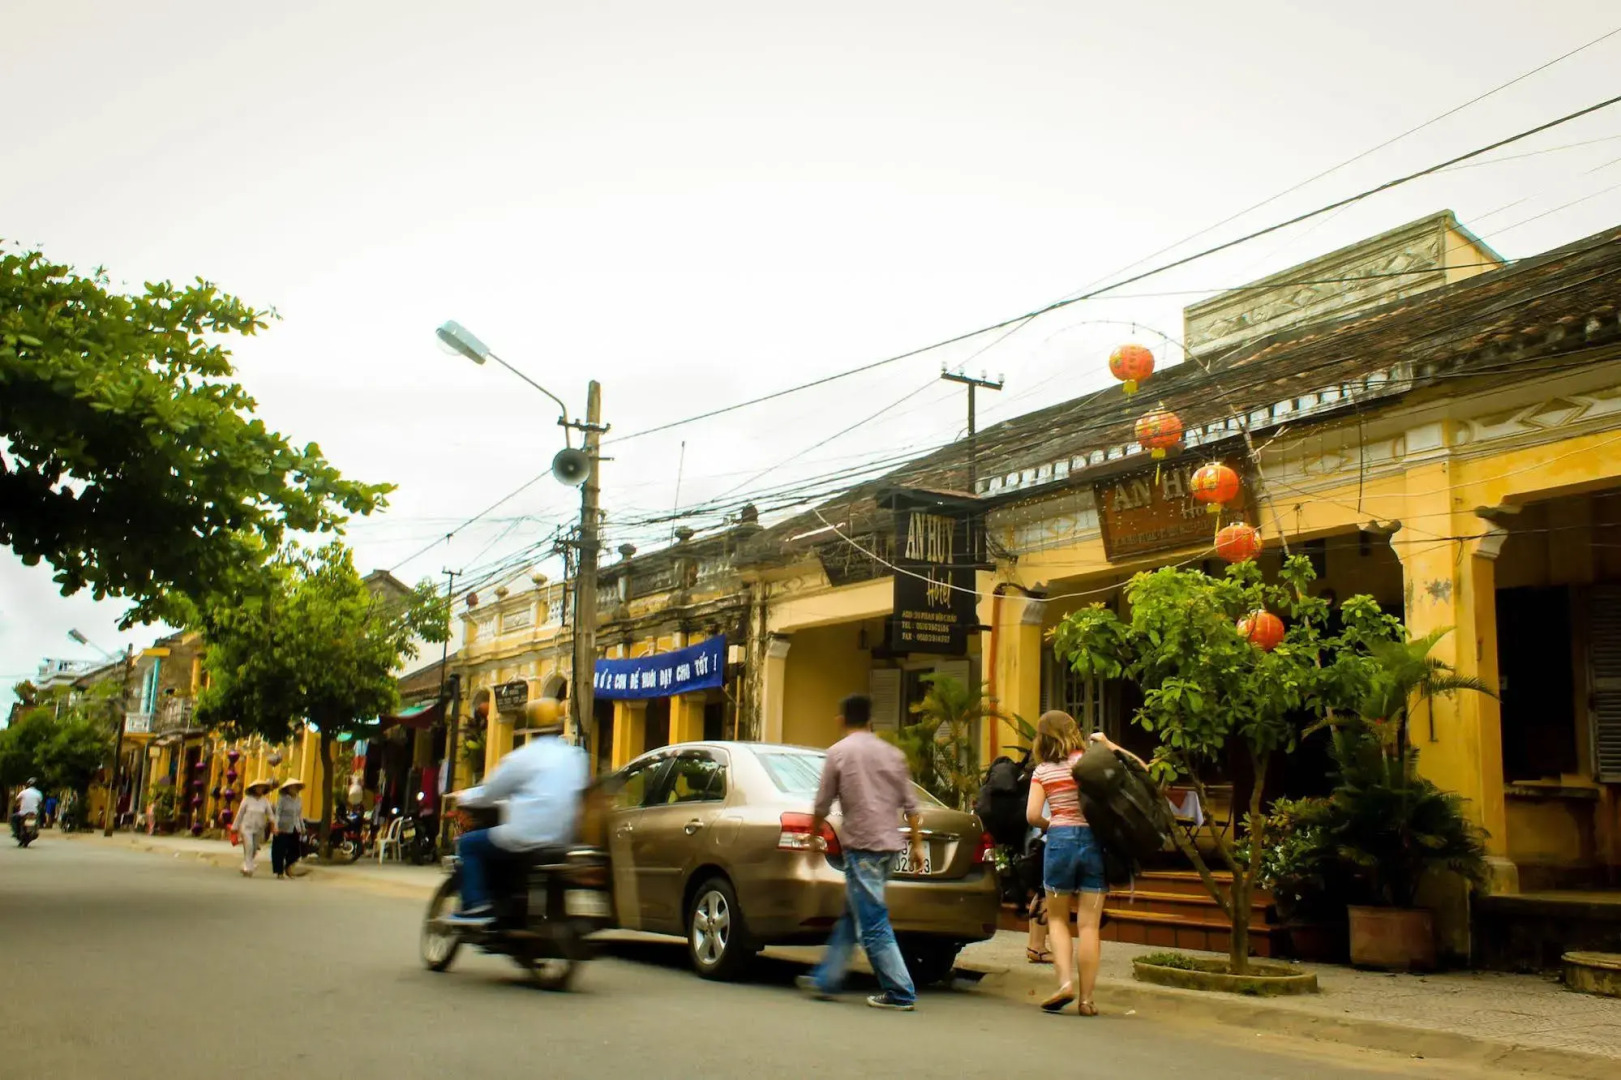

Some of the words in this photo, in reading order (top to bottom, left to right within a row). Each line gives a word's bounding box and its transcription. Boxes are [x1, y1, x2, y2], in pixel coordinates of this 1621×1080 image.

[1112, 476, 1152, 512] AN
[905, 512, 926, 561] AN
[927, 514, 956, 564] HUY
[926, 565, 953, 609] Hotel
[676, 663, 691, 682] CHO
[694, 651, 709, 676] TỐT
